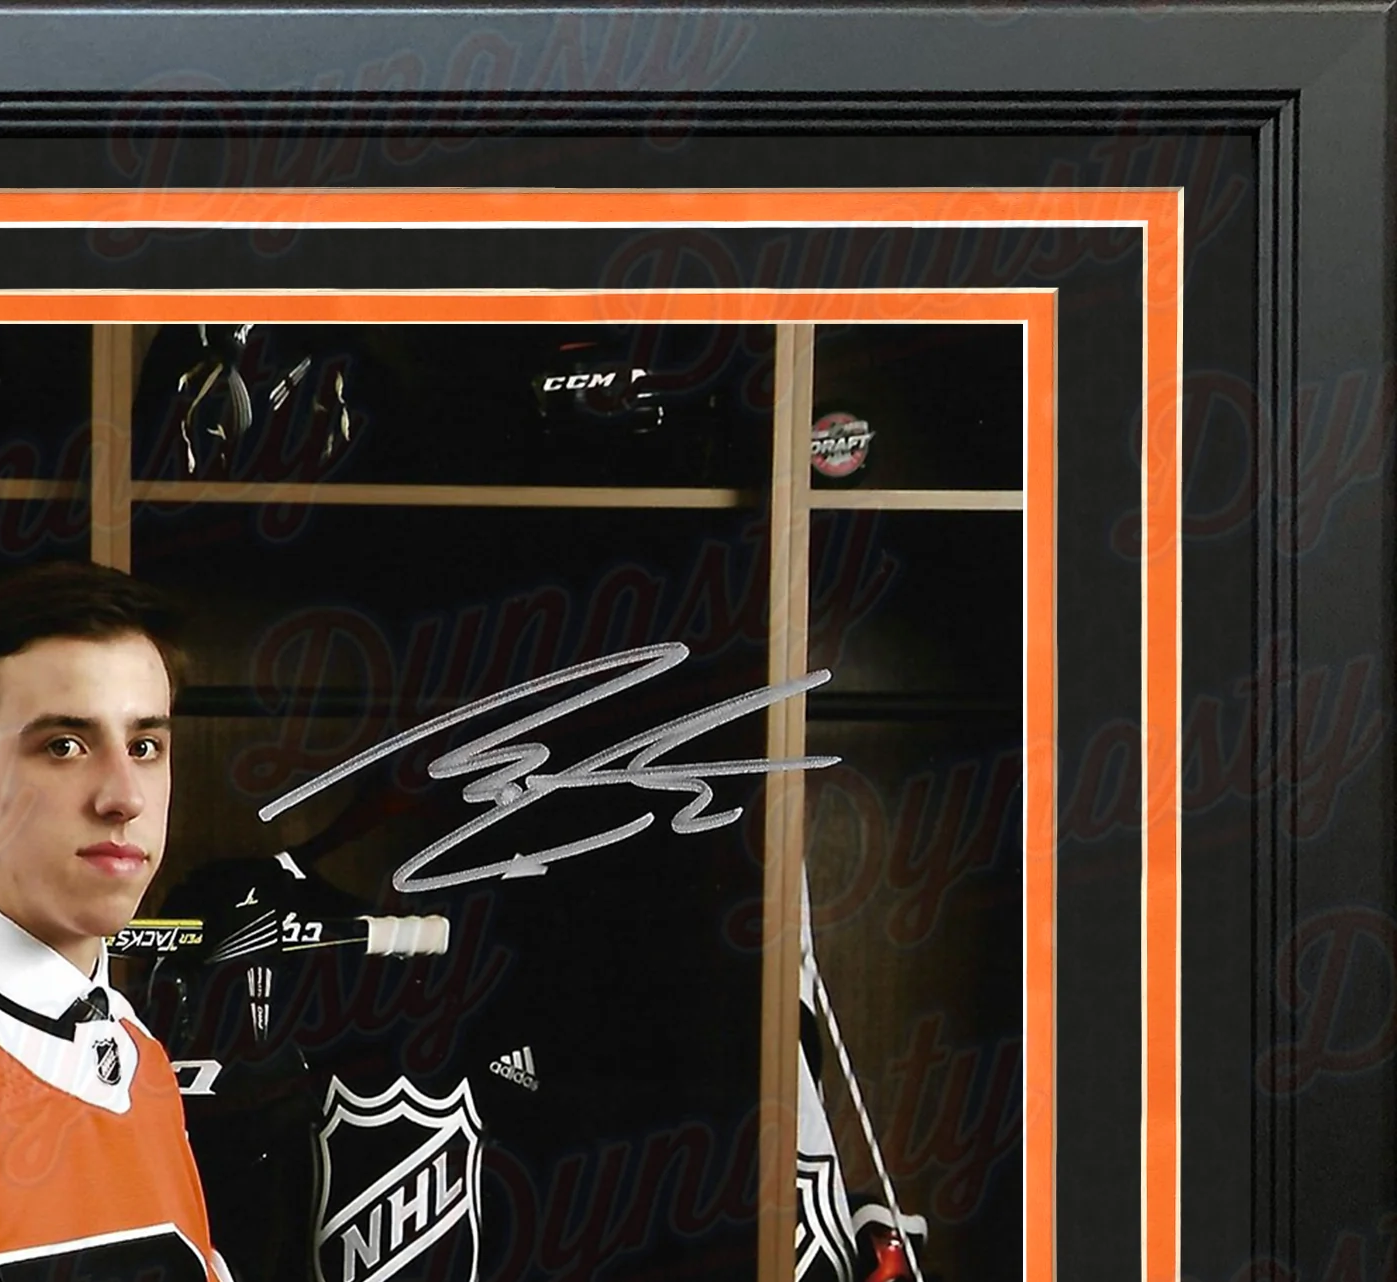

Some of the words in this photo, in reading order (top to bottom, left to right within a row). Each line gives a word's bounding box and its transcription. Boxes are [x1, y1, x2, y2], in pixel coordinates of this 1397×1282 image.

[544, 373, 616, 391] CCM
[115, 926, 179, 951] TACKS
[489, 1061, 539, 1091] adidas
